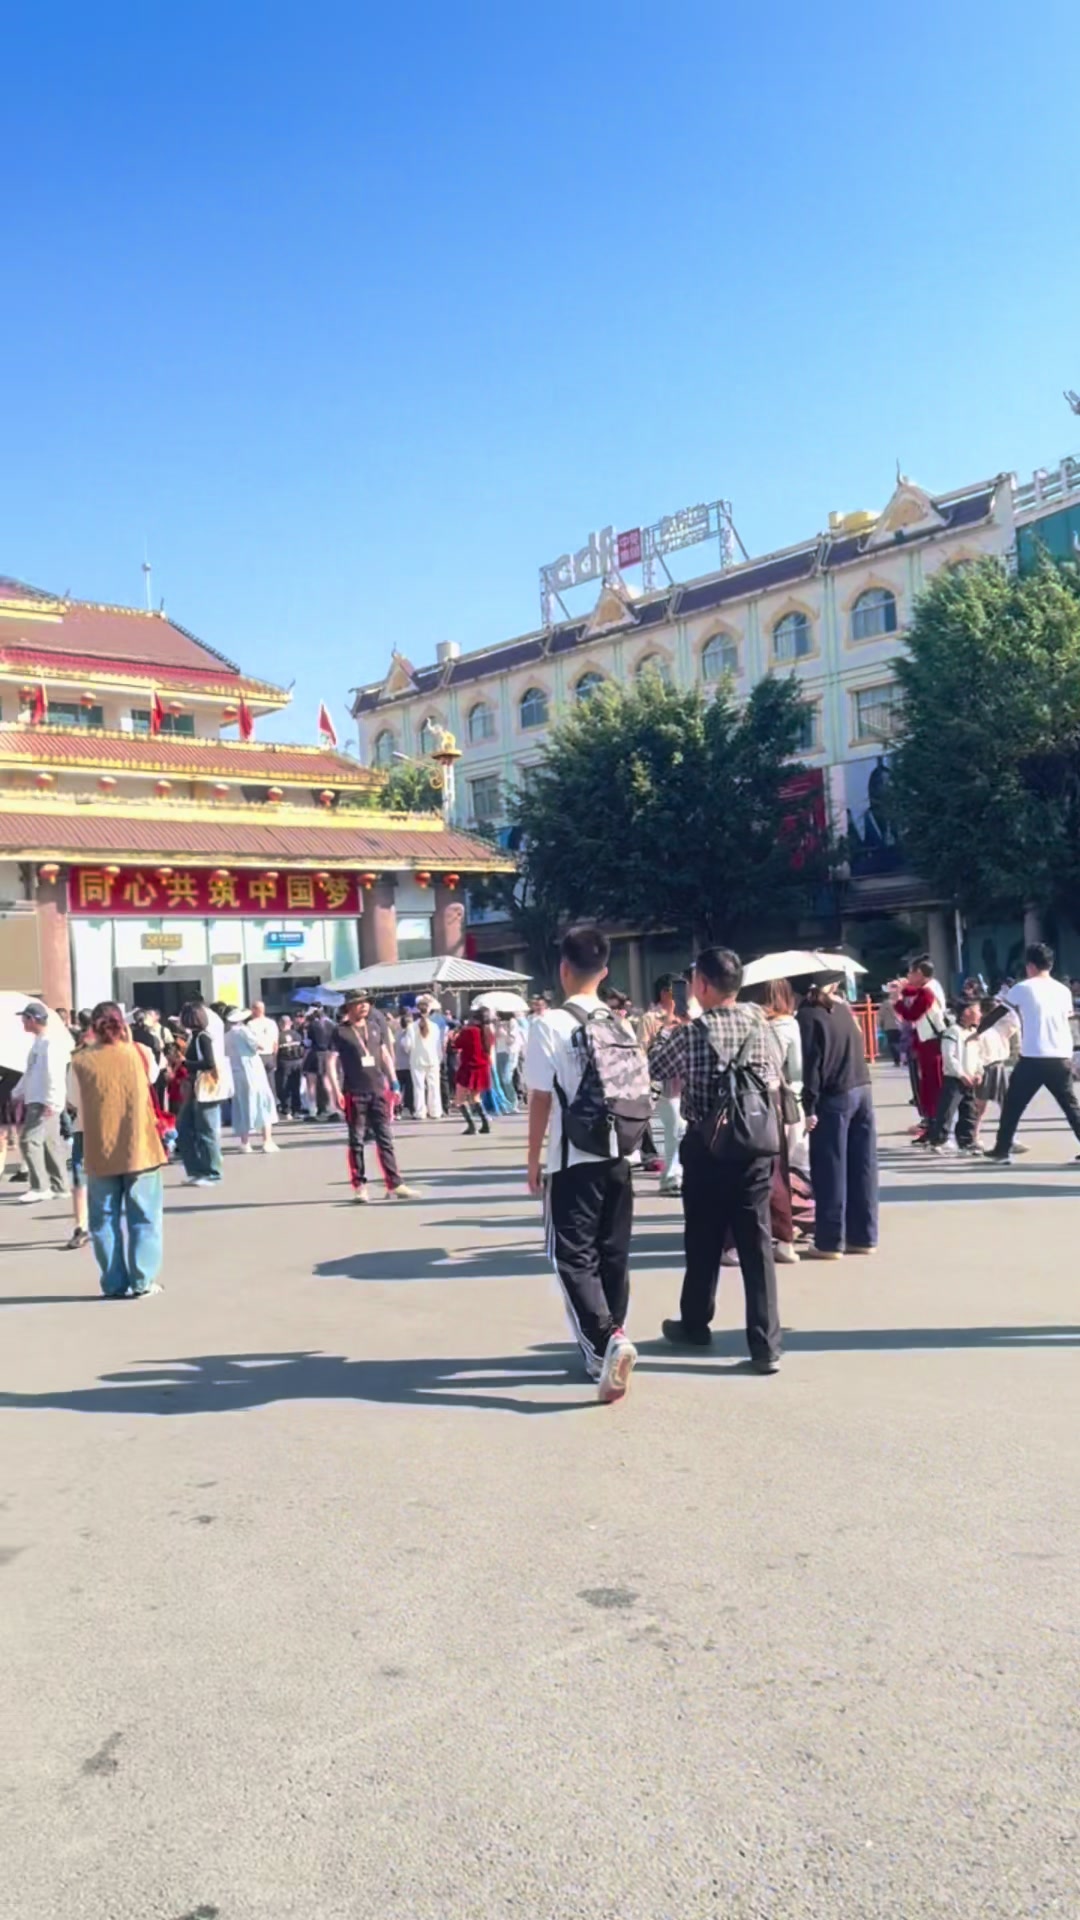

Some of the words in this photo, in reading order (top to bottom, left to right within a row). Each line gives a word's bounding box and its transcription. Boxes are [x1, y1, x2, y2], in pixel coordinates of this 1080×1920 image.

[550, 525, 613, 591] cdf
[79, 870, 349, 909] 同心共筑中国梦
